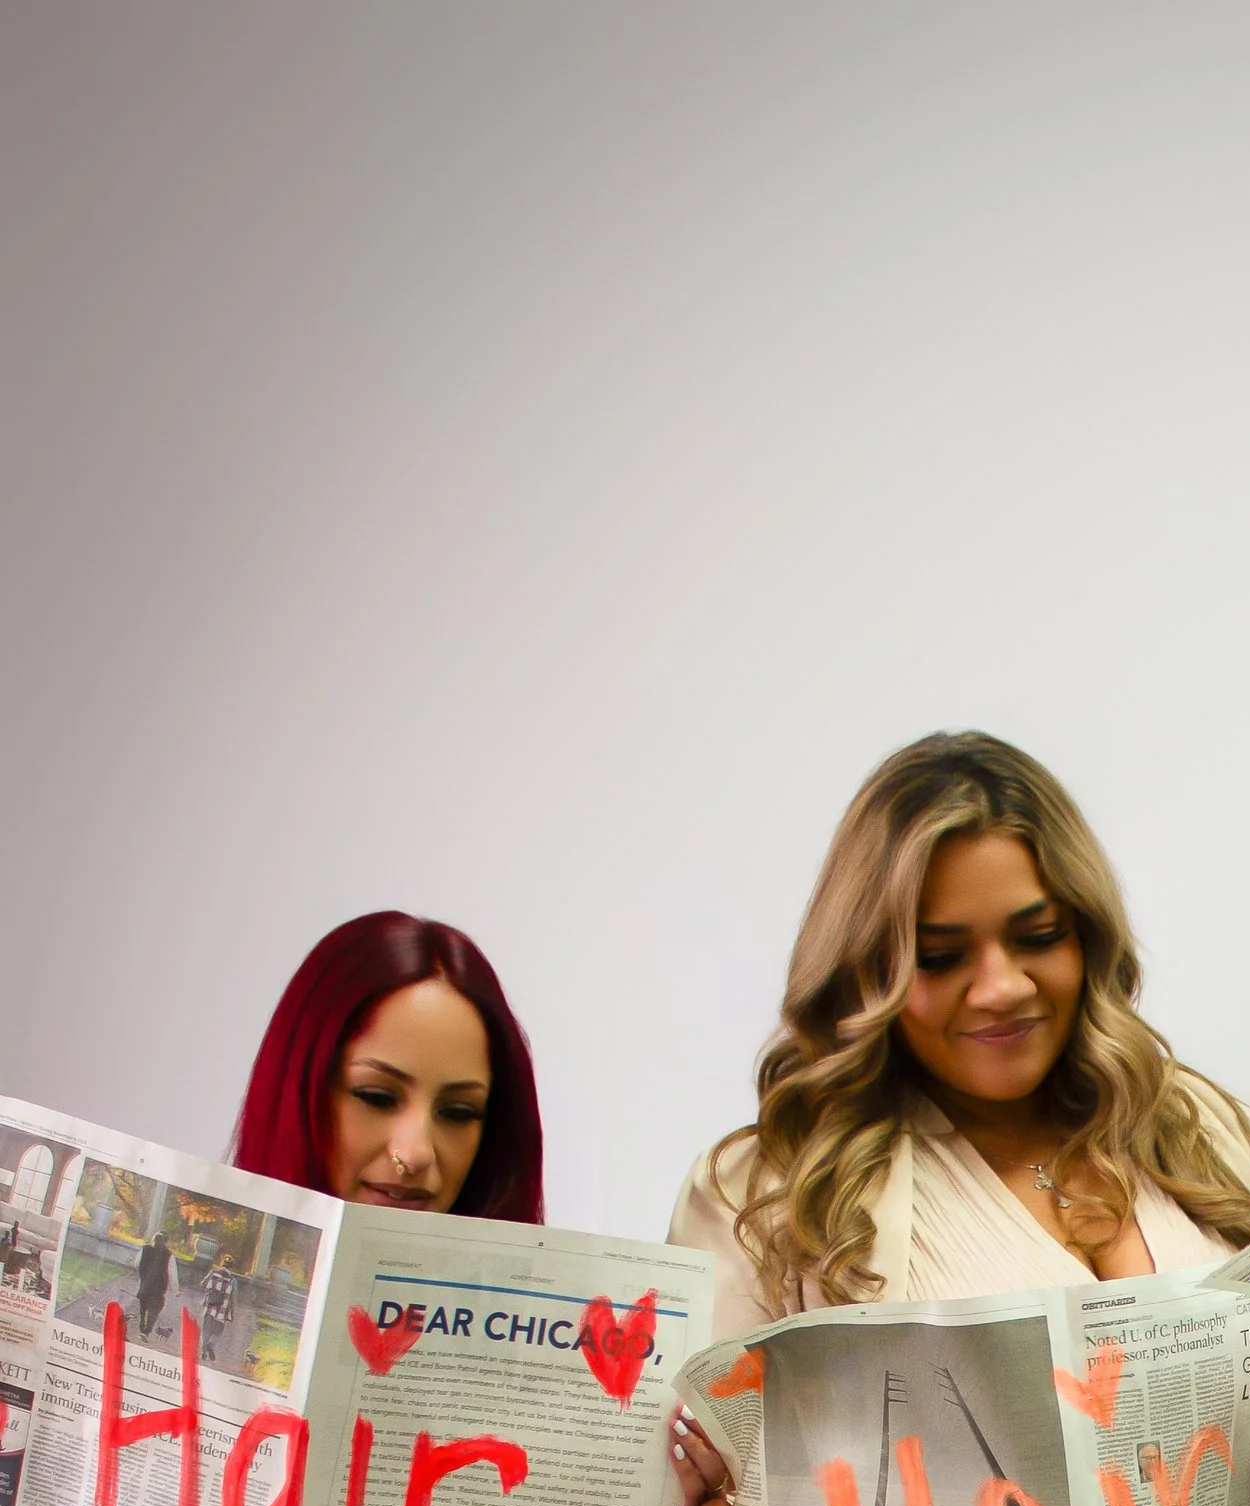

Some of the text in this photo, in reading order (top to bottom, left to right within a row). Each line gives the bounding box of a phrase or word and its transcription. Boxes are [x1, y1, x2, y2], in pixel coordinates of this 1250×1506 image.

[1081, 1296, 1136, 1311] OBITUARIES
[52, 1329, 89, 1352] March
[377, 1301, 664, 1366] DEAR CHICAGO,
[1085, 1313, 1228, 1349] Noted U. of C. philosophy
[1087, 1334, 1224, 1370] professor, psychoanalyst
[44, 1372, 73, 1390] New
[129, 1355, 200, 1386] Chihuahs
[40, 1389, 100, 1418] immigran
